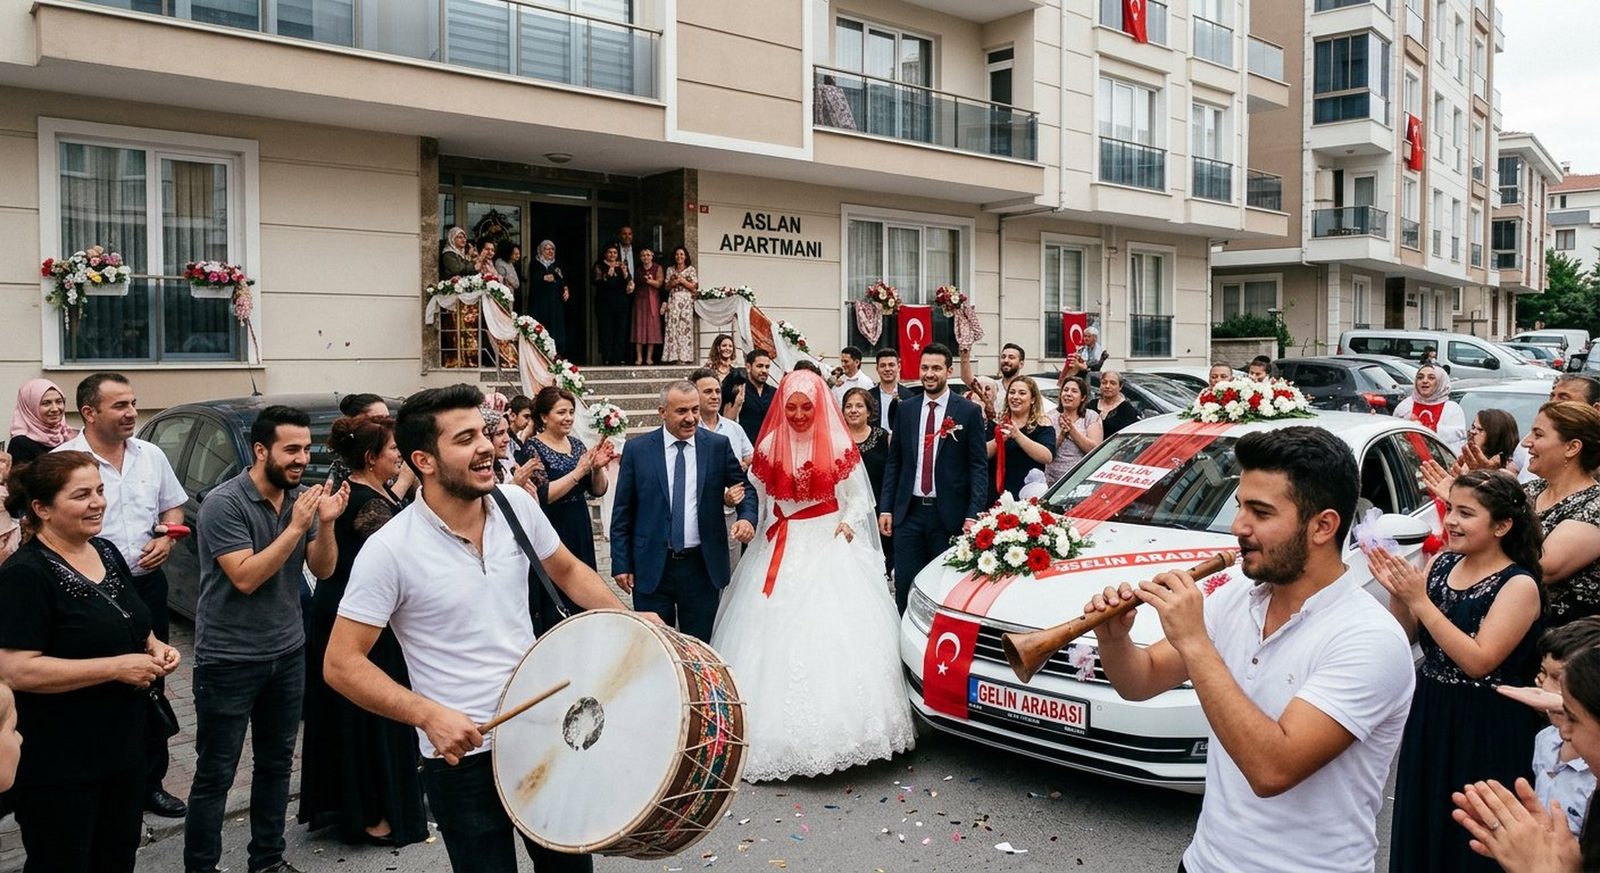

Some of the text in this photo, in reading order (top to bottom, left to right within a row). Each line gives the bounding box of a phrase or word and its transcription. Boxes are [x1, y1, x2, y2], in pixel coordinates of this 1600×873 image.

[742, 212, 801, 233] ASLAN
[720, 234, 822, 258] APARTMANI
[979, 684, 1017, 709] GELİN
[1021, 695, 1082, 724] ARABASI
